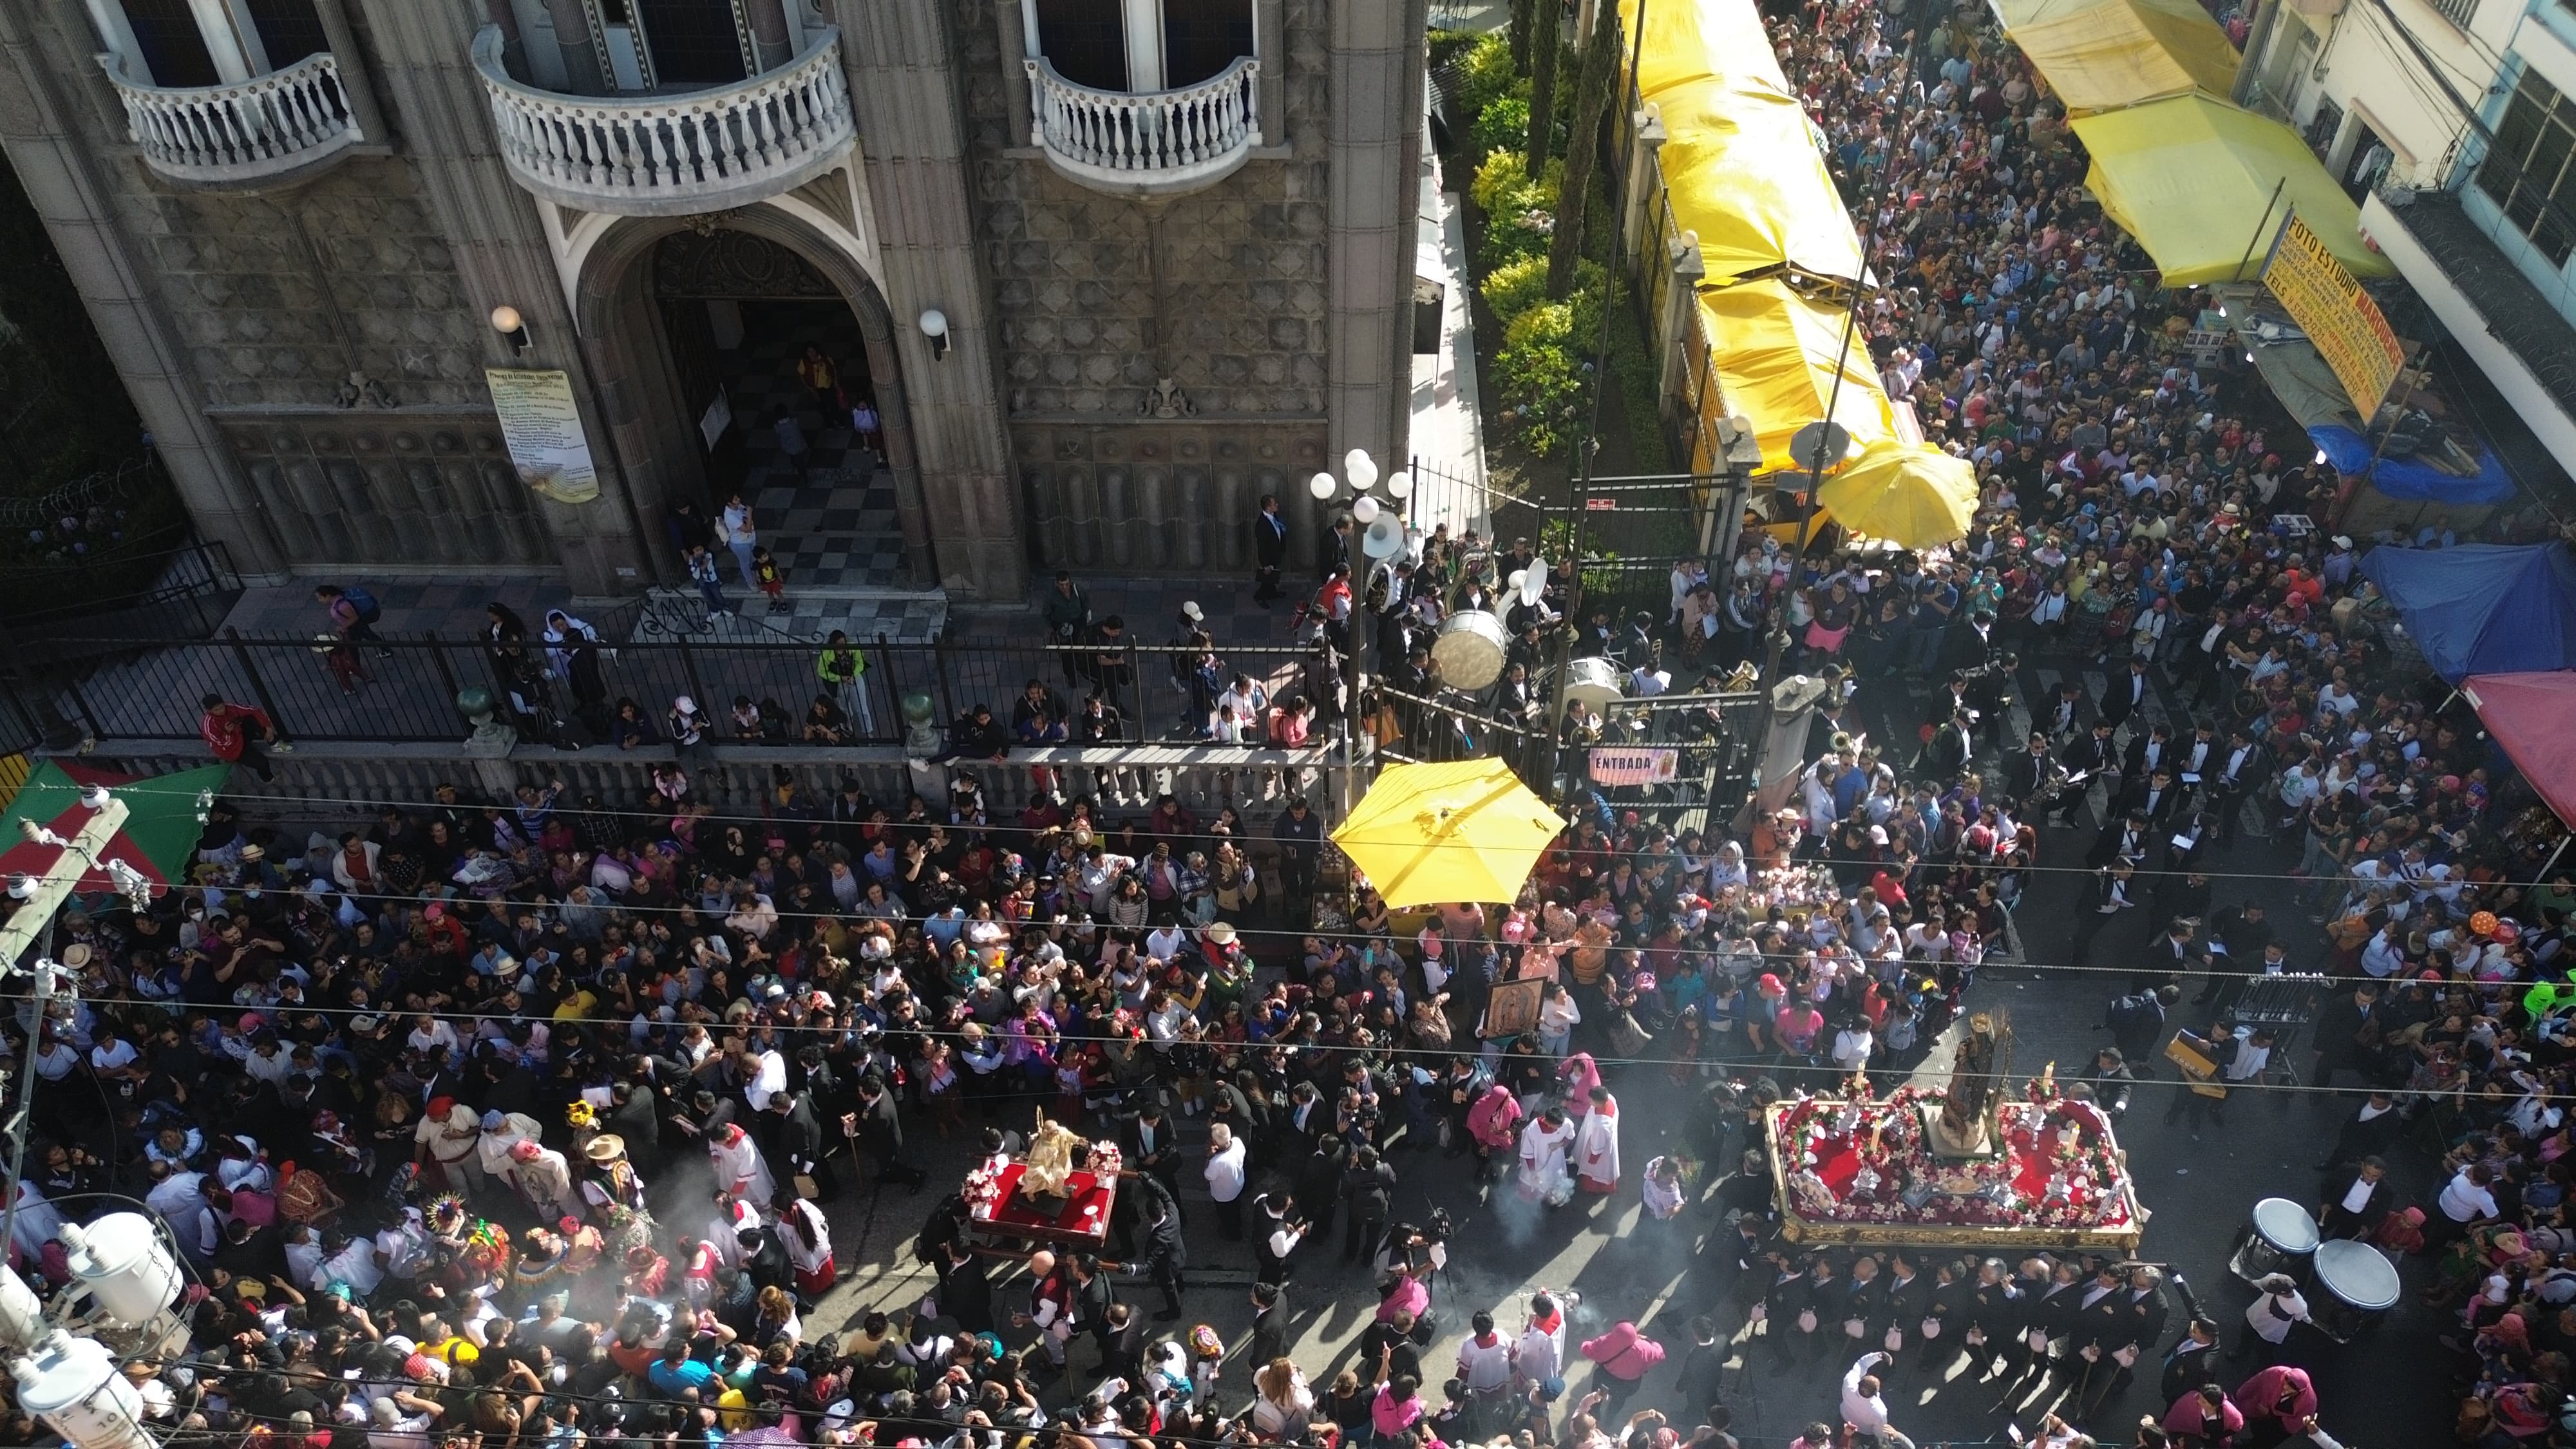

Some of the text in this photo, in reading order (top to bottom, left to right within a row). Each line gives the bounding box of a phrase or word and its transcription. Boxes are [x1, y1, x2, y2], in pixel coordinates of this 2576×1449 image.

[2277, 246, 2306, 280] MERCADO
[2306, 278, 2333, 310] CENTRAL
[2349, 328, 2365, 354] CALLE
[2280, 238, 2306, 269] PUESTO
[2355, 324, 2374, 354] SECTOR
[2287, 215, 2319, 254] FOTO
[2316, 245, 2358, 299] ESTUDIO
[2312, 262, 2324, 277] SUS
[2323, 274, 2342, 296] FOTOS
[2350, 306, 2367, 332] TIENDA
[2299, 292, 2314, 313] BUEN
[2356, 368, 2365, 386] DIA
[1595, 757, 1651, 770] ENTRADA
